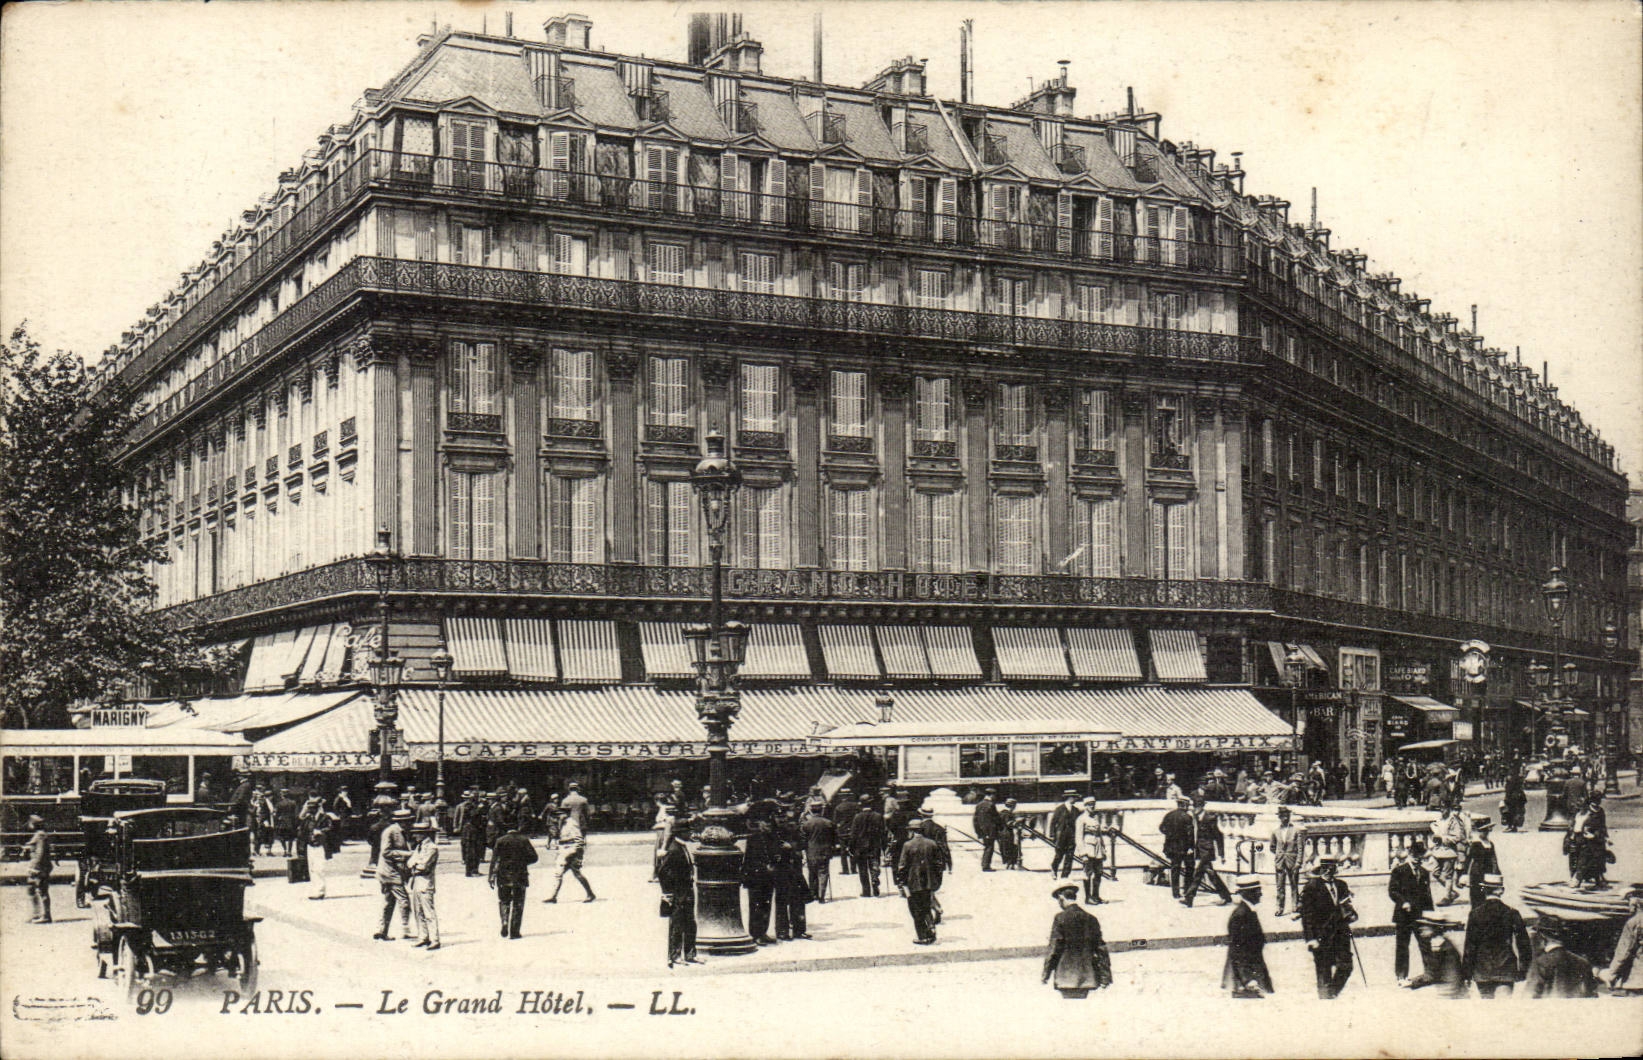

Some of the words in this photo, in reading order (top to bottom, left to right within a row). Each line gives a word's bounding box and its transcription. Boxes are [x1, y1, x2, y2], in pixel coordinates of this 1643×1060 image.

[207, 335, 260, 390] HOTEL
[727, 568, 857, 599] GRAND
[886, 573, 1004, 600] HOTEL
[92, 710, 145, 727] MARIGNY
[1313, 706, 1335, 717] BAR
[1175, 739, 1191, 749] DE
[1195, 739, 1212, 749] LA
[1216, 736, 1272, 748] PAIX
[454, 743, 538, 757] CAFE
[765, 743, 783, 754] DE
[789, 743, 808, 753] LA
[243, 754, 290, 767] CAFE
[319, 753, 378, 767] PAIX
